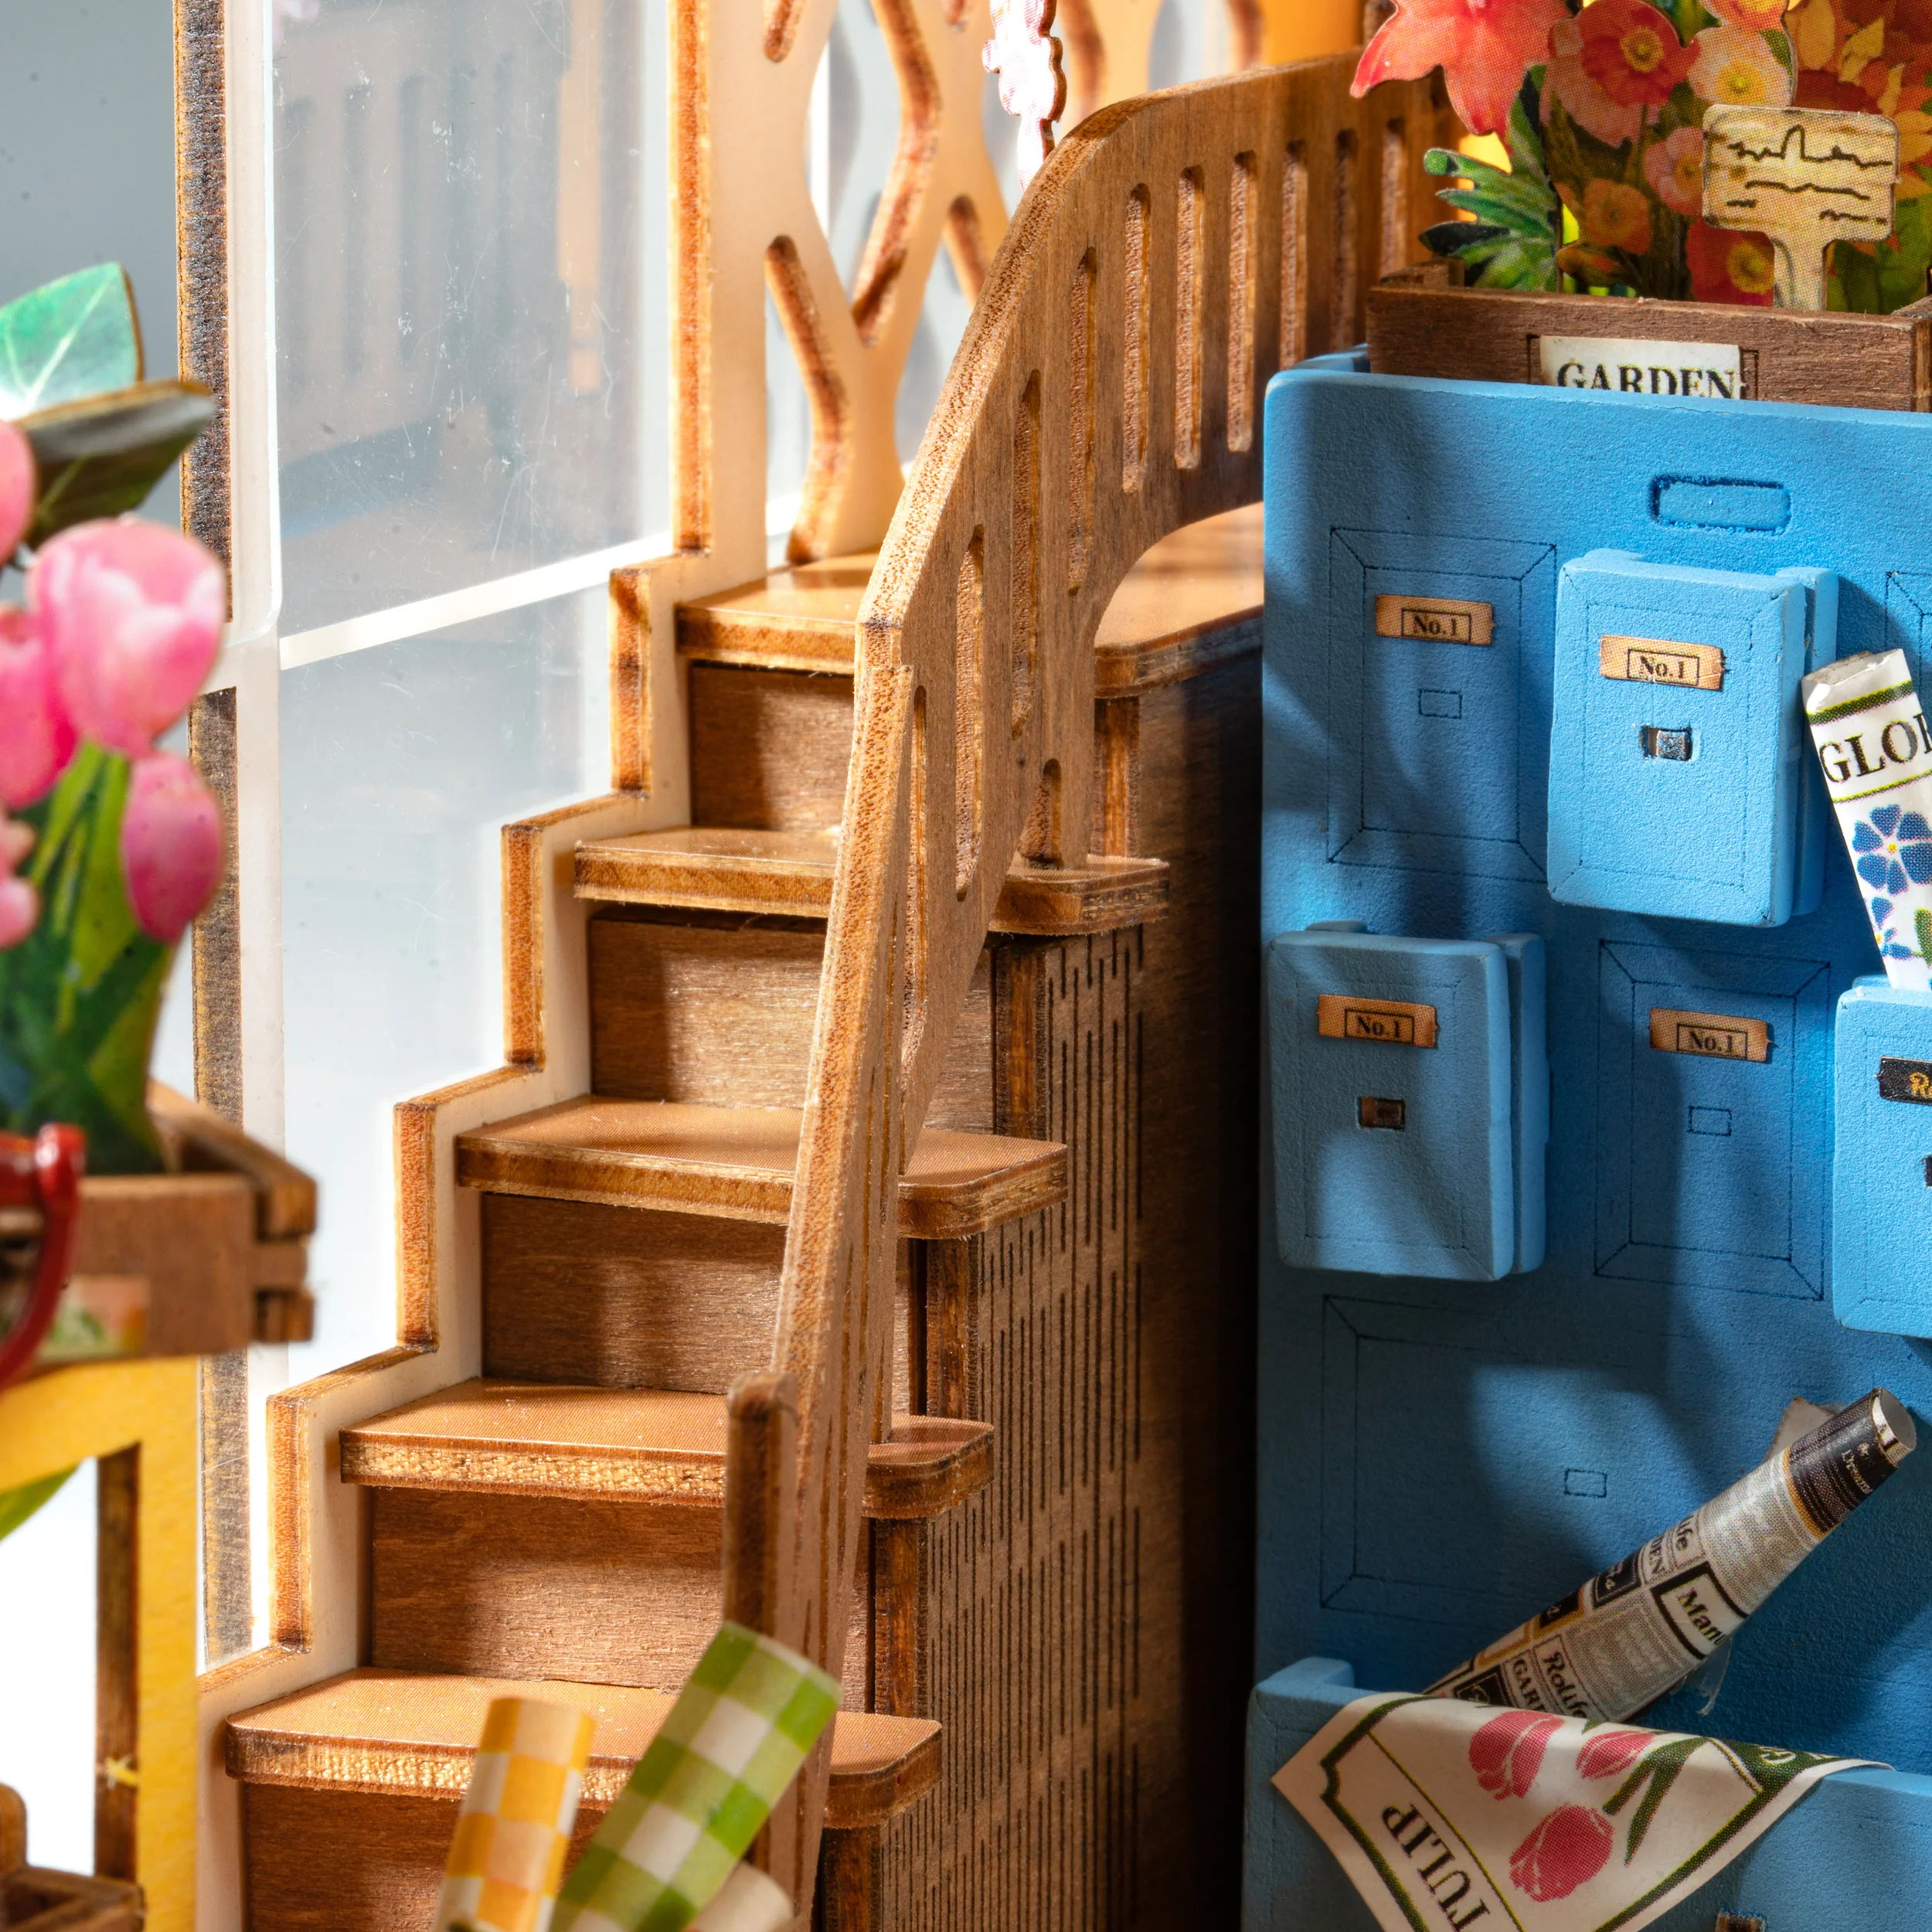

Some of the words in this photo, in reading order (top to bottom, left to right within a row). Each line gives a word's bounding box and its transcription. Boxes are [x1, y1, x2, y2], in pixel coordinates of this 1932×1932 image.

[1556, 359, 1737, 400] GARDEN
[1413, 615, 1457, 636] No.1
[1640, 655, 1685, 679] No.1
[1357, 1015, 1401, 1038] No.1
[1689, 1031, 1733, 1052] No.1
[1381, 1802, 1491, 1932] TULIP
